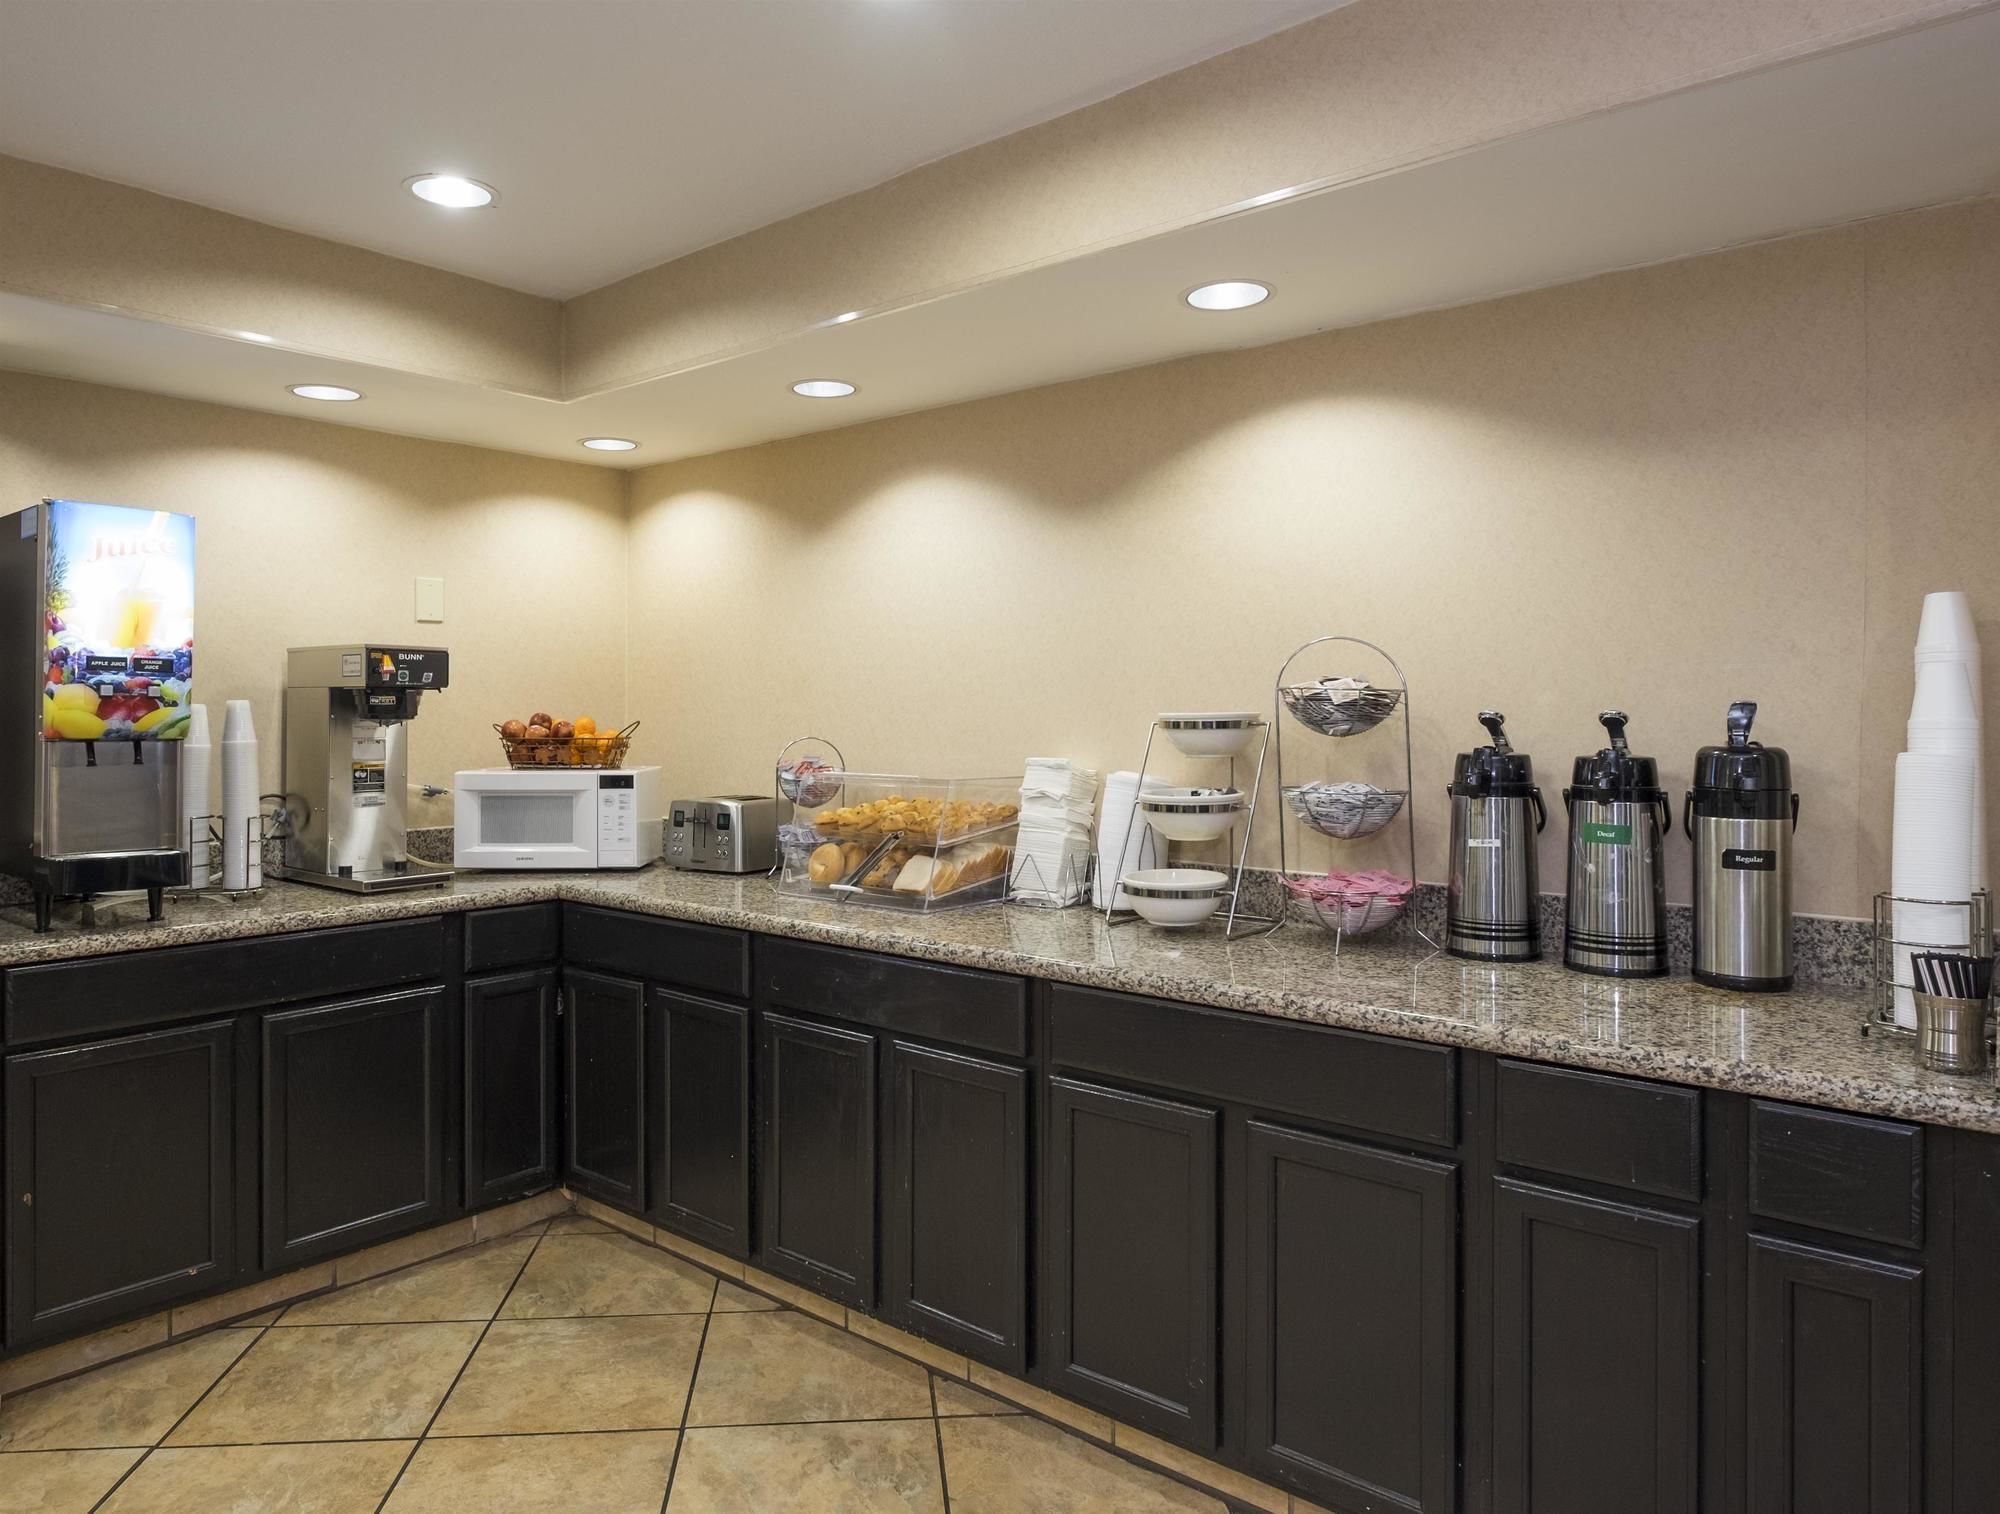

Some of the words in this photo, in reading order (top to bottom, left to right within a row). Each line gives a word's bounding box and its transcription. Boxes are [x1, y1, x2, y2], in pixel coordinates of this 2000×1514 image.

[398, 653, 424, 661] BUNN
[1596, 830, 1616, 838] Decaf
[1735, 855, 1764, 864] Regular
